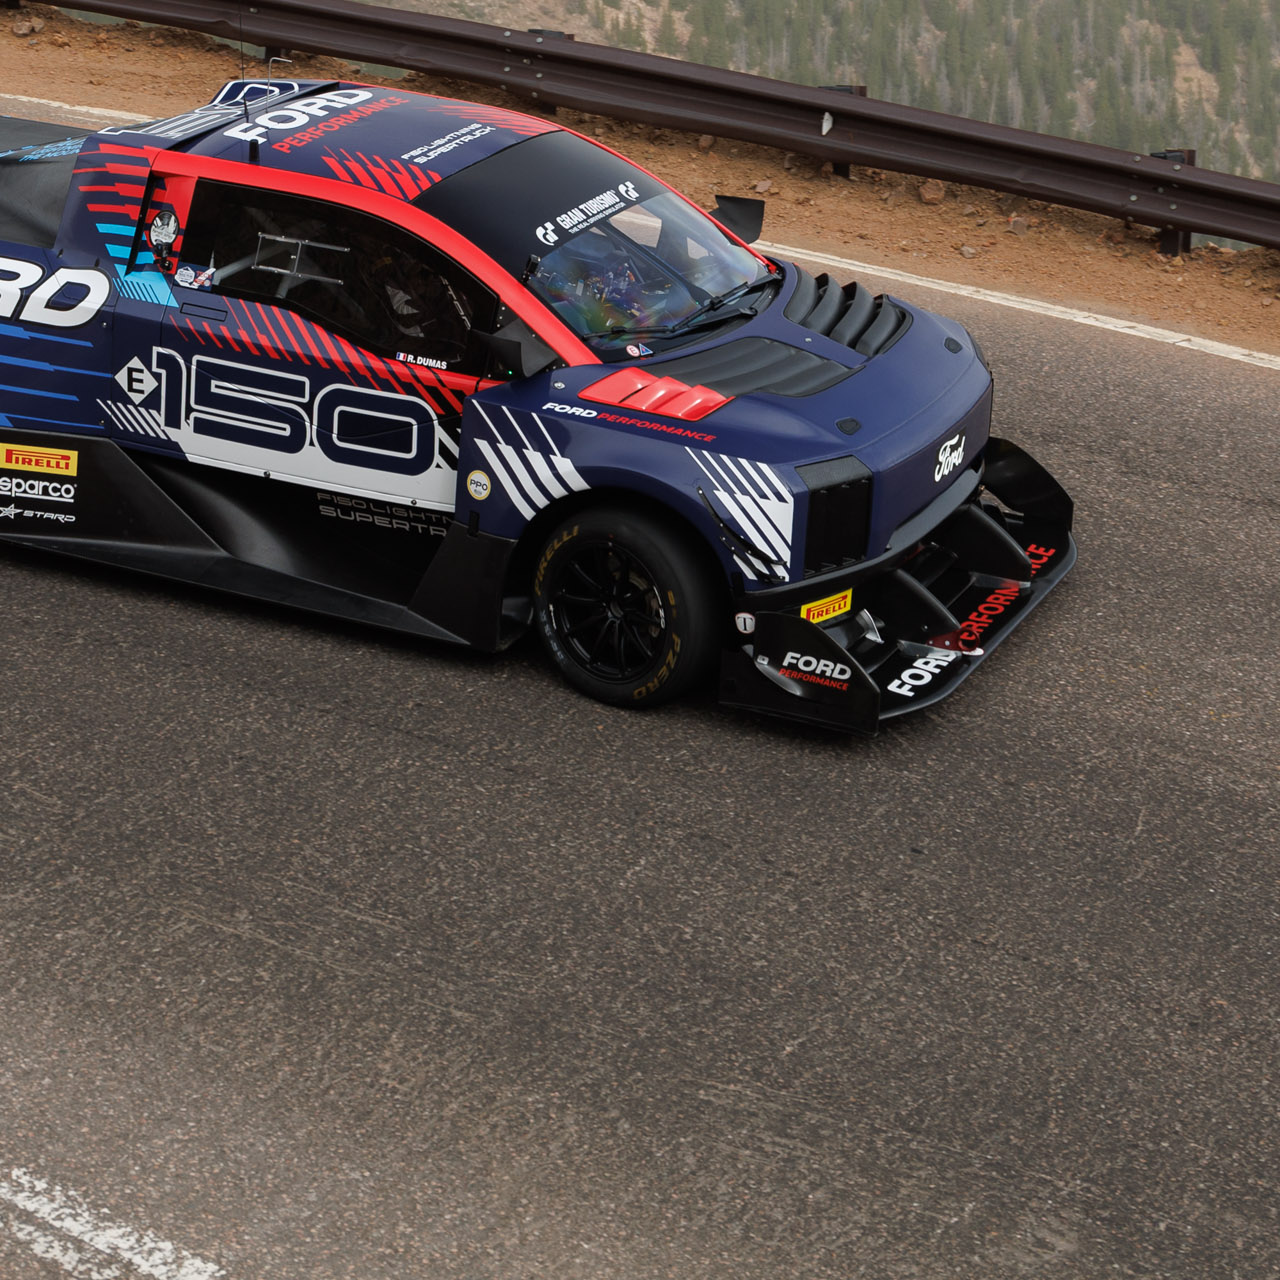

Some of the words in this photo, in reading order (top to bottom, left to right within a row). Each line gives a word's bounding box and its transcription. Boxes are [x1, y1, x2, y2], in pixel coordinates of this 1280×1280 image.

[223, 89, 373, 144] FORD
[271, 96, 411, 154] PERFORMANCE
[413, 126, 496, 164] SUPERTRUCK
[556, 208, 587, 229] GRAN
[578, 190, 620, 216] TURISMO
[407, 354, 417, 364] R.
[417, 356, 448, 369] DUMAS
[127, 366, 145, 394] E
[152, 346, 438, 477] 150
[542, 402, 598, 418] FORD
[596, 412, 717, 443] PERFORMANCE
[5, 448, 71, 471] PIRELLI
[935, 434, 966, 482] Ford
[470, 479, 488, 491] PPO
[316, 492, 367, 509] F150
[22, 510, 76, 523] STARD
[806, 594, 848, 621] PIRELLI
[778, 668, 849, 691] PERFORMANCE
[782, 652, 852, 680] FORD
